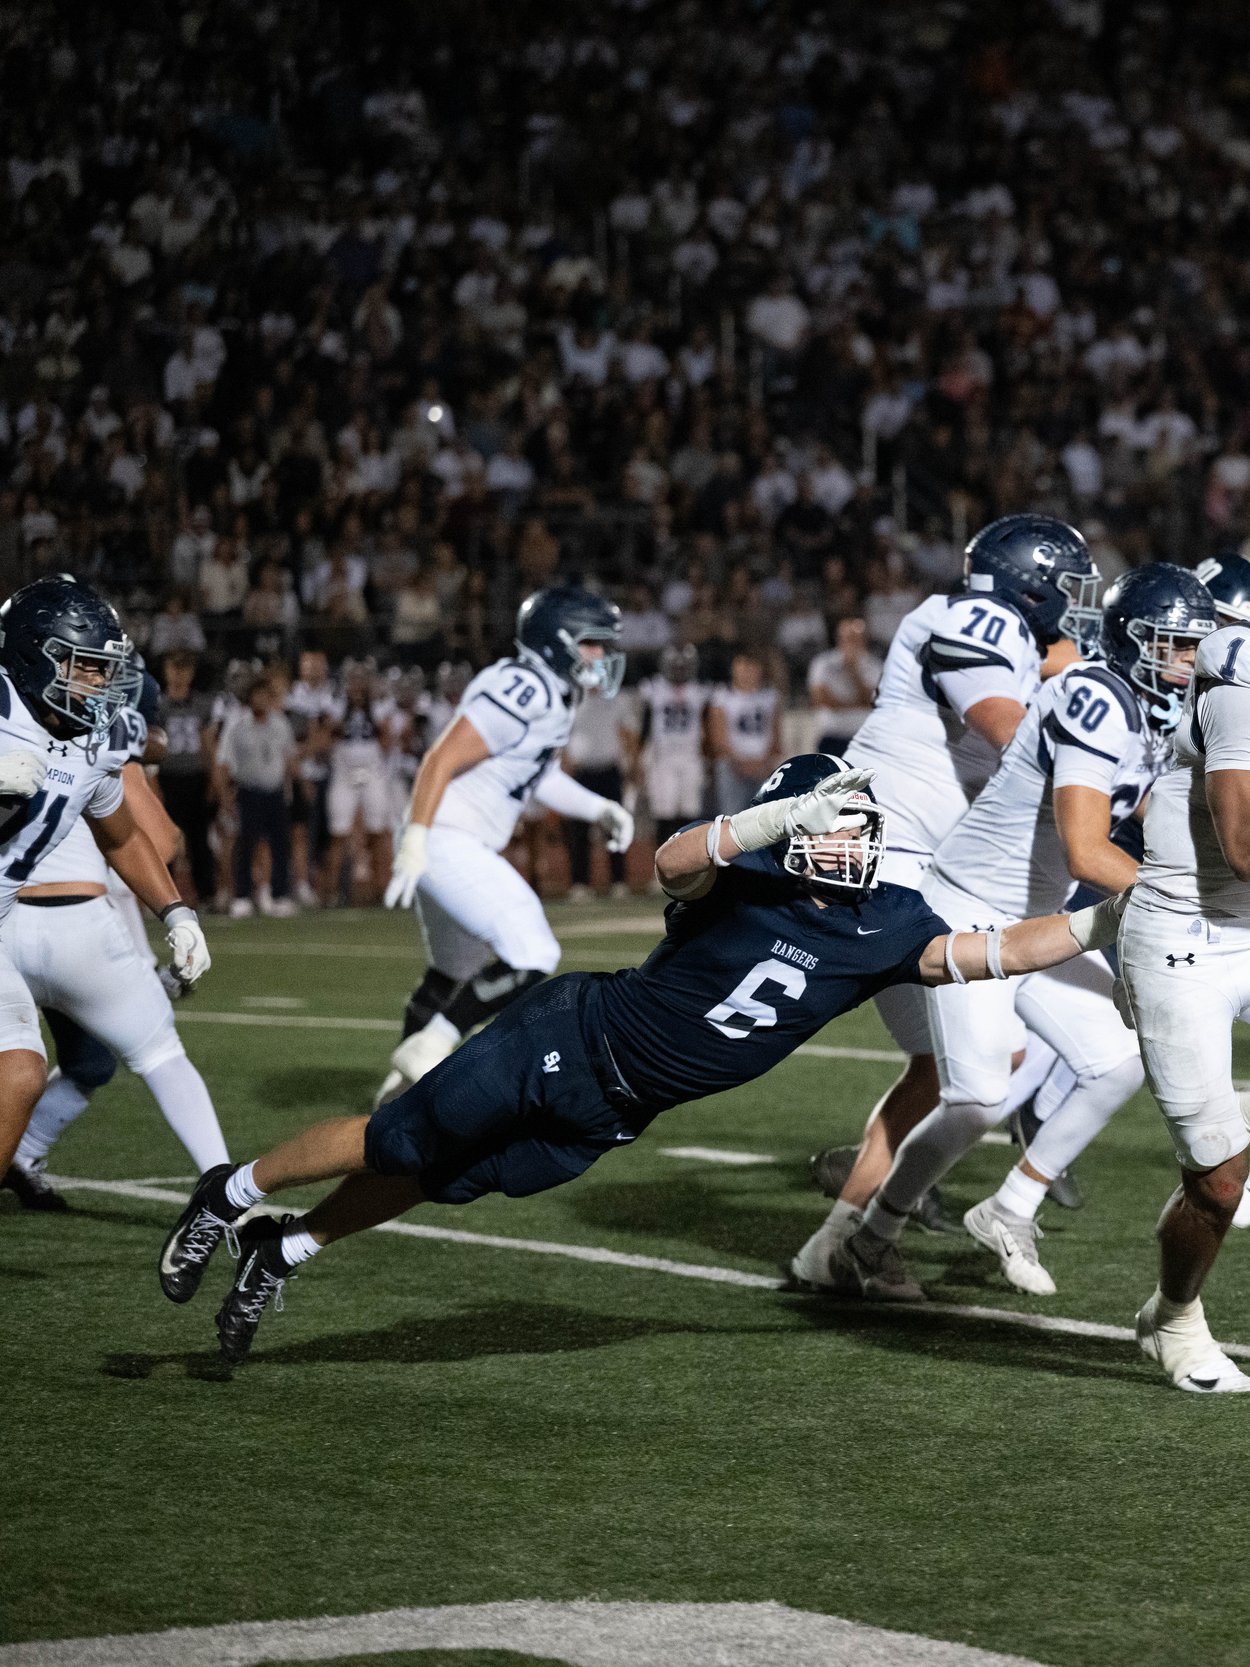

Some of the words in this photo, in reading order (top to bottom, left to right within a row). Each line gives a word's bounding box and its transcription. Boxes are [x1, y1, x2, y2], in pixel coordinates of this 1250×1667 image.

[960, 606, 1007, 646] 70
[1219, 637, 1246, 681] 1
[503, 675, 537, 707] 78
[1066, 685, 1110, 733] 60
[766, 762, 792, 792] 6
[770, 939, 820, 970] RANGERS
[703, 958, 808, 1039] 6
